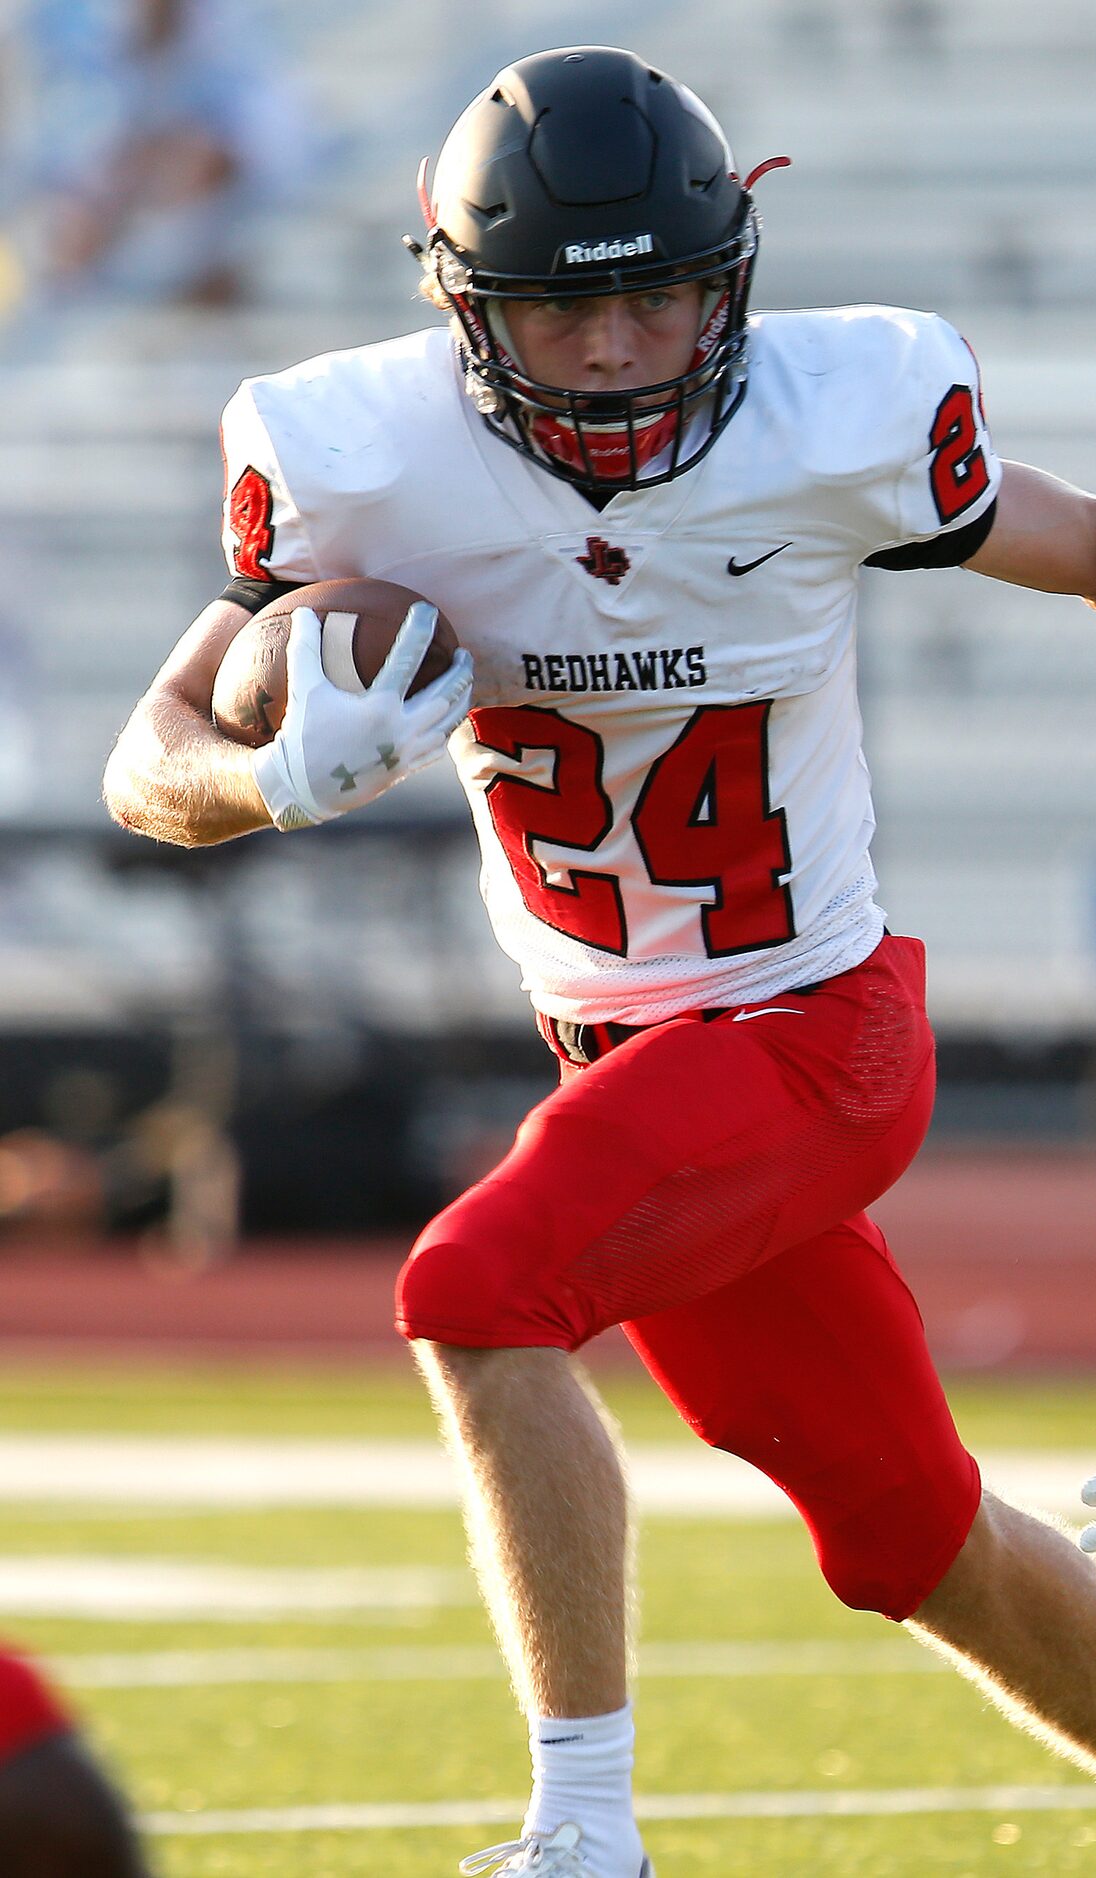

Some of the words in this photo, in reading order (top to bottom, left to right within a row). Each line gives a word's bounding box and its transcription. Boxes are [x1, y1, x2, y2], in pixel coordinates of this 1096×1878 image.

[565, 234, 653, 264] Riddell
[521, 646, 707, 692] REDHAWKS
[467, 699, 798, 959] 24
